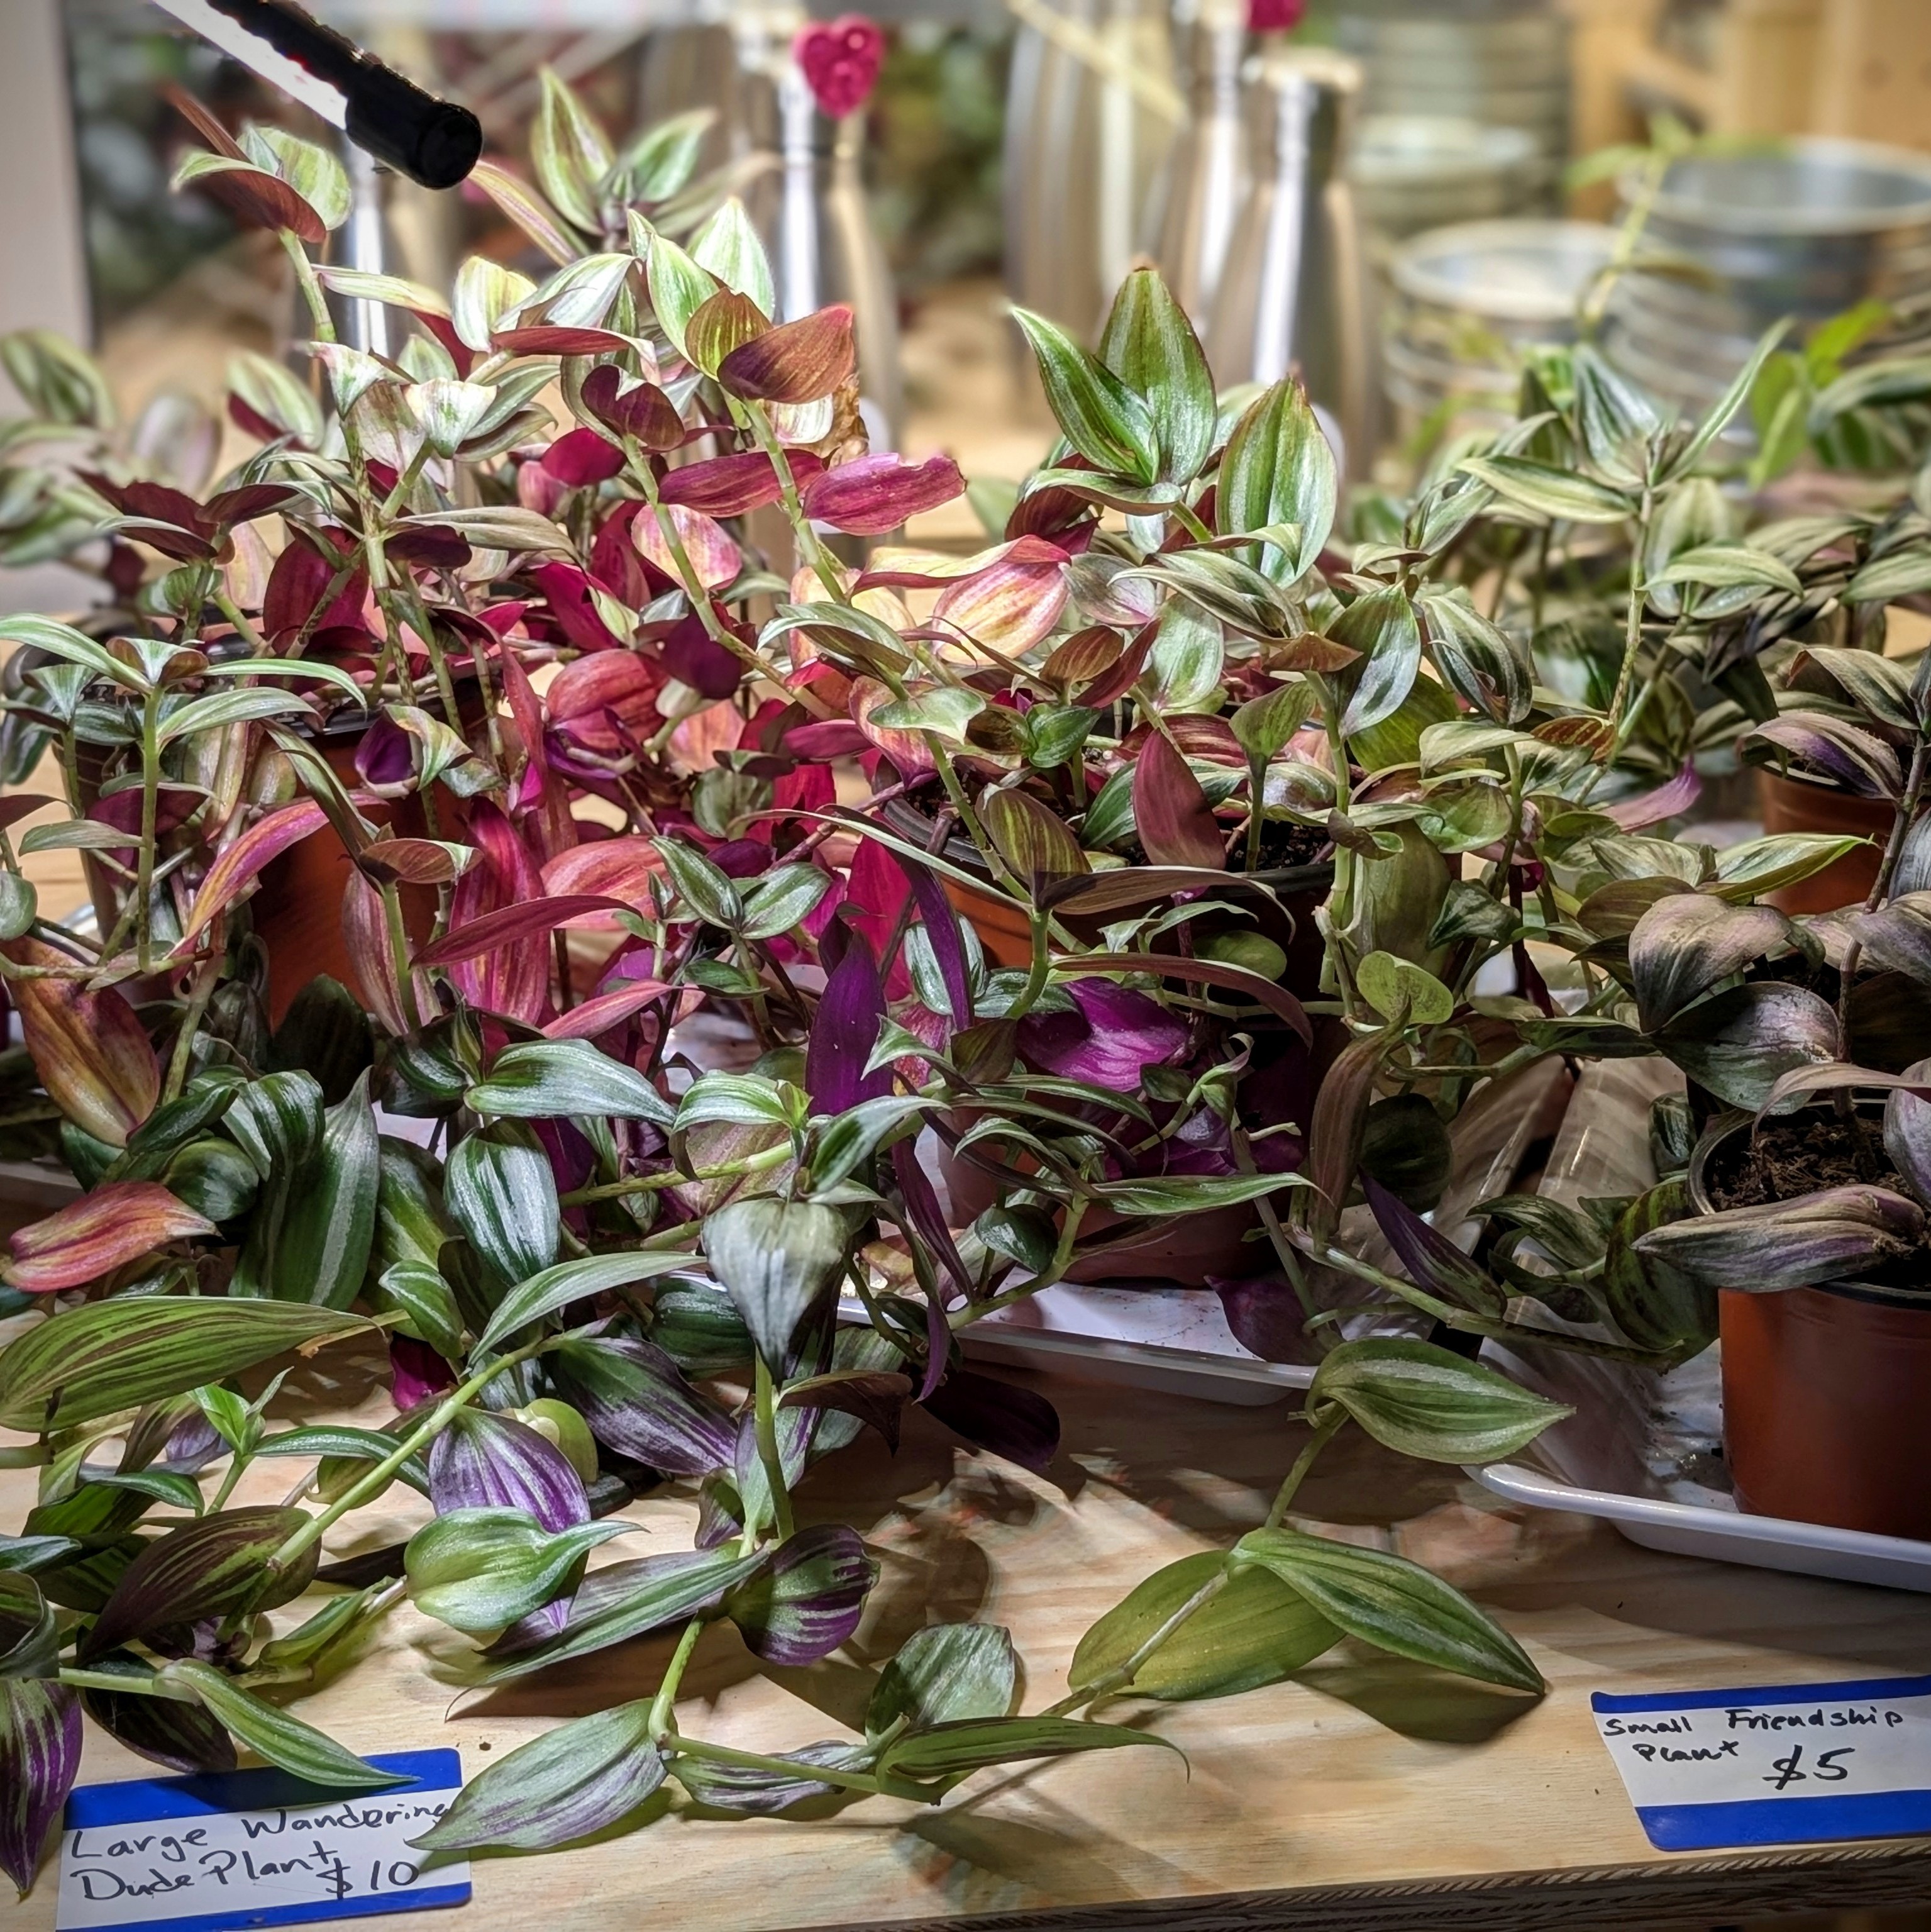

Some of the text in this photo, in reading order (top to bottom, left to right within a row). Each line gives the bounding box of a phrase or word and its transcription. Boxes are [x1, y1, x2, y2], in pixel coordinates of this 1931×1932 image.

[1604, 1706, 1903, 1736] Small Friendship
[1633, 1741, 1739, 1762] Plant
[1762, 1745, 1856, 1790] $5
[71, 1828, 207, 1862] Large
[70, 1840, 338, 1900] Dude Plant
[316, 1857, 419, 1900] $10
